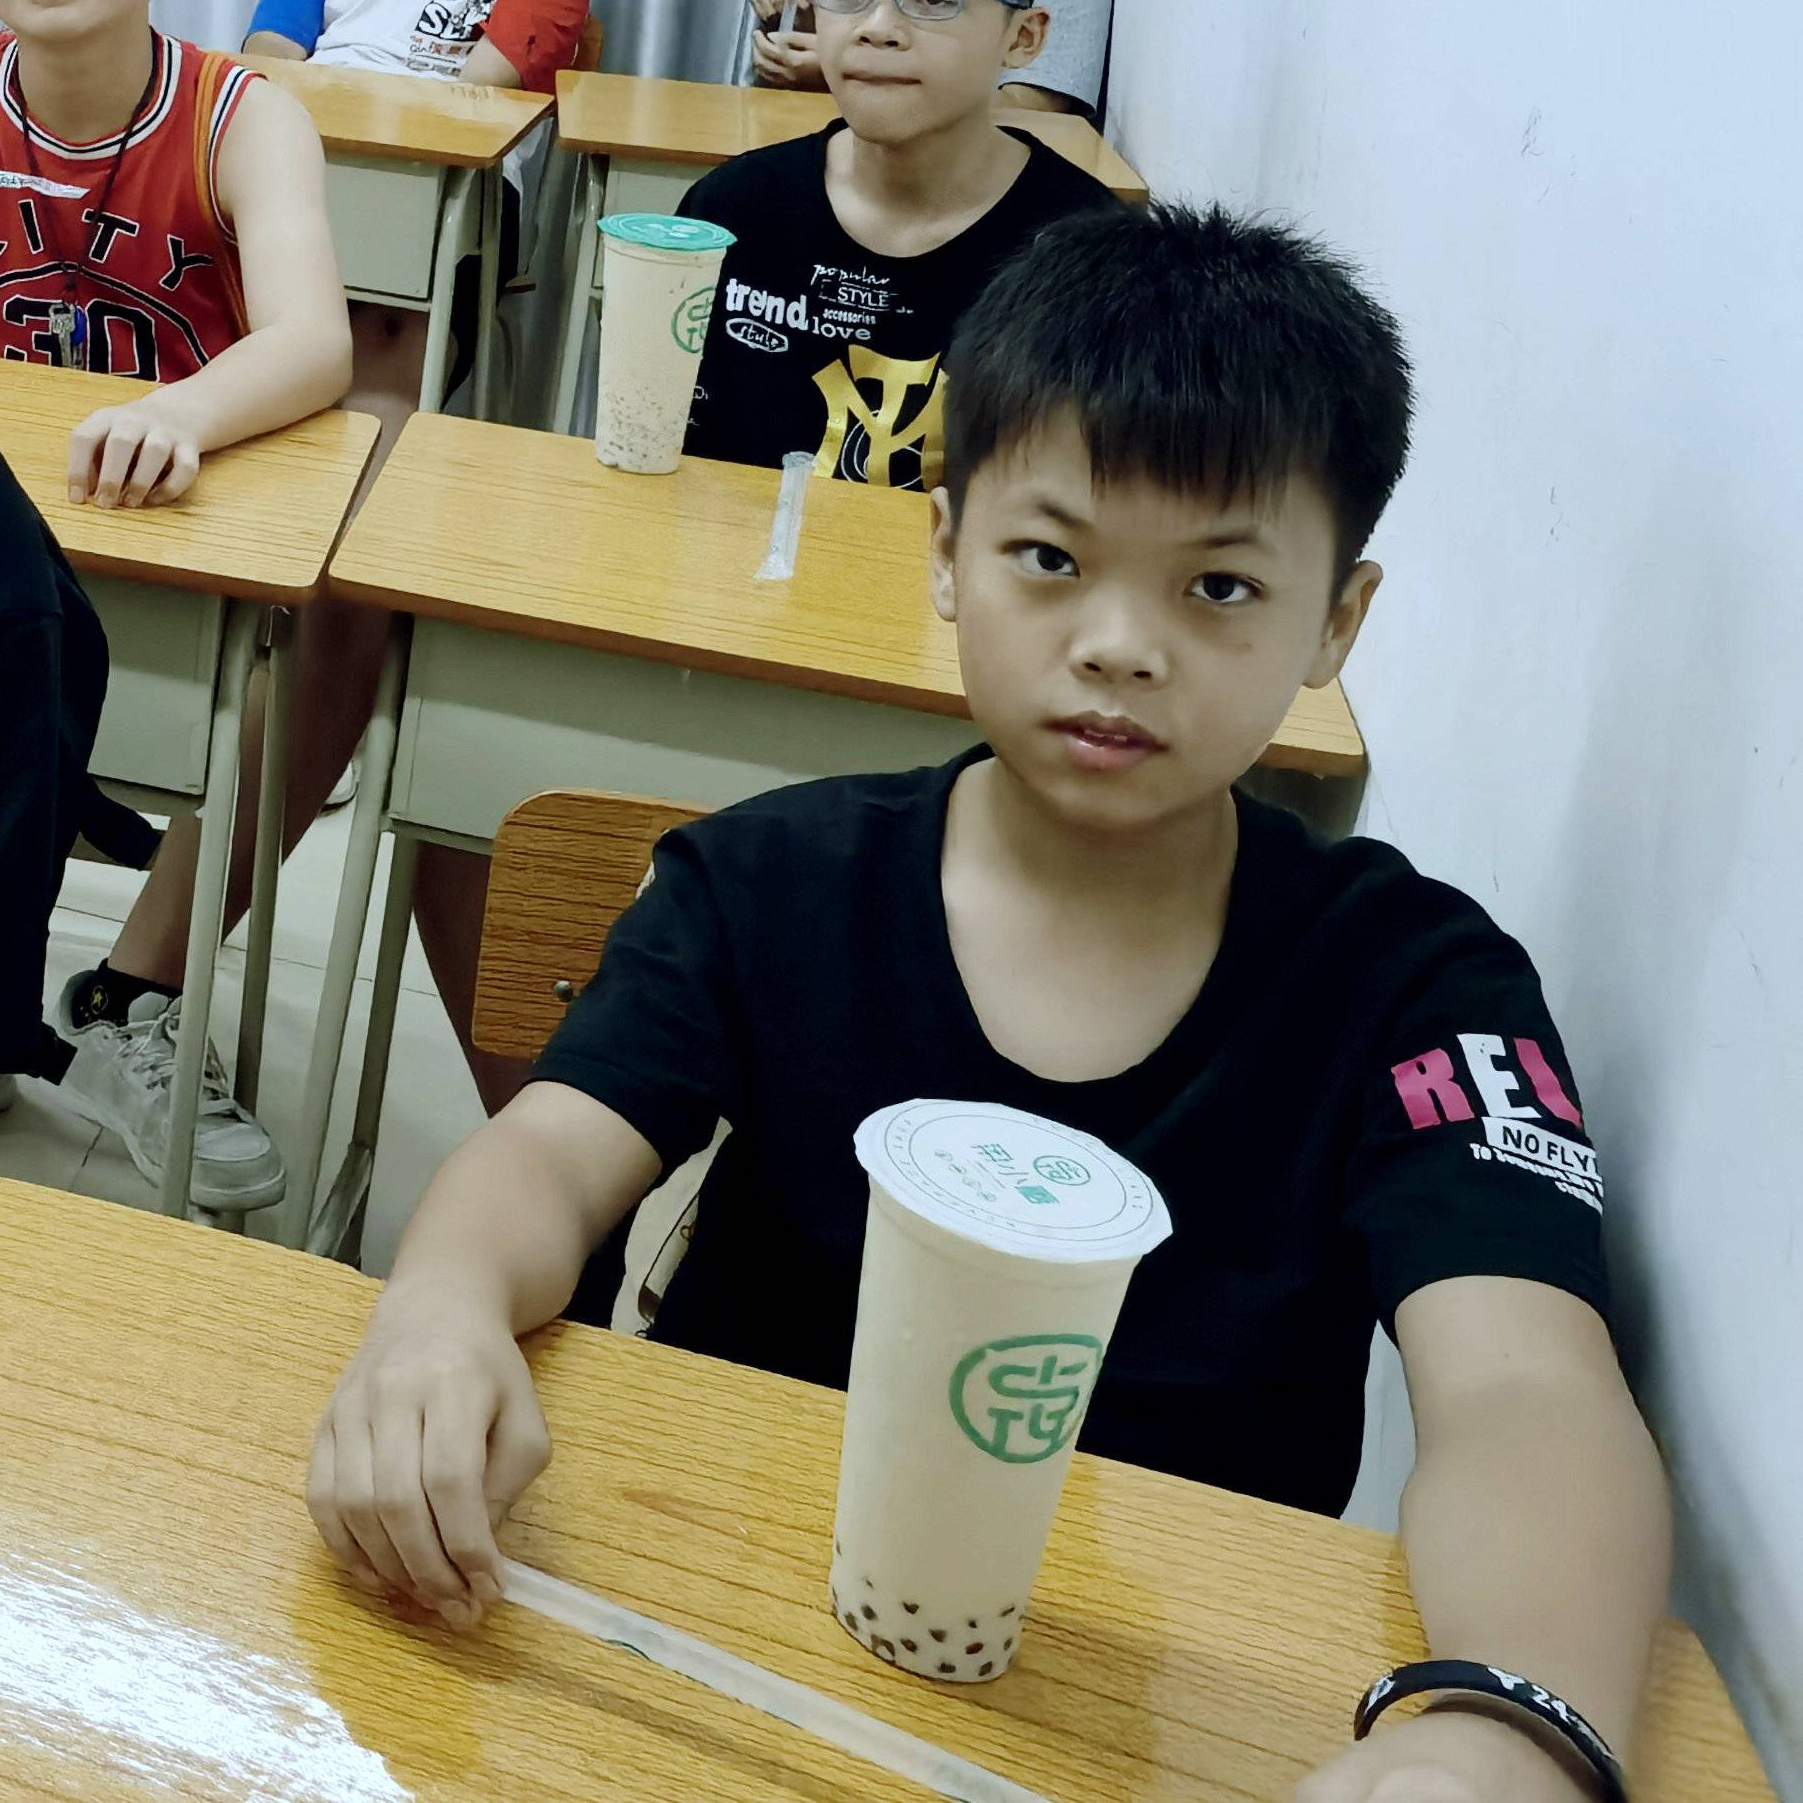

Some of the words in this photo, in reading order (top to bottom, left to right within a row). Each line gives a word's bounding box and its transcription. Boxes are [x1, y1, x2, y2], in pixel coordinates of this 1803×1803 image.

[725, 277, 809, 331] trend
[836, 285, 890, 308] STYLE
[811, 316, 872, 341] love
[1502, 1125, 1540, 1154] NO
[1547, 1140, 1589, 1172] FLY
